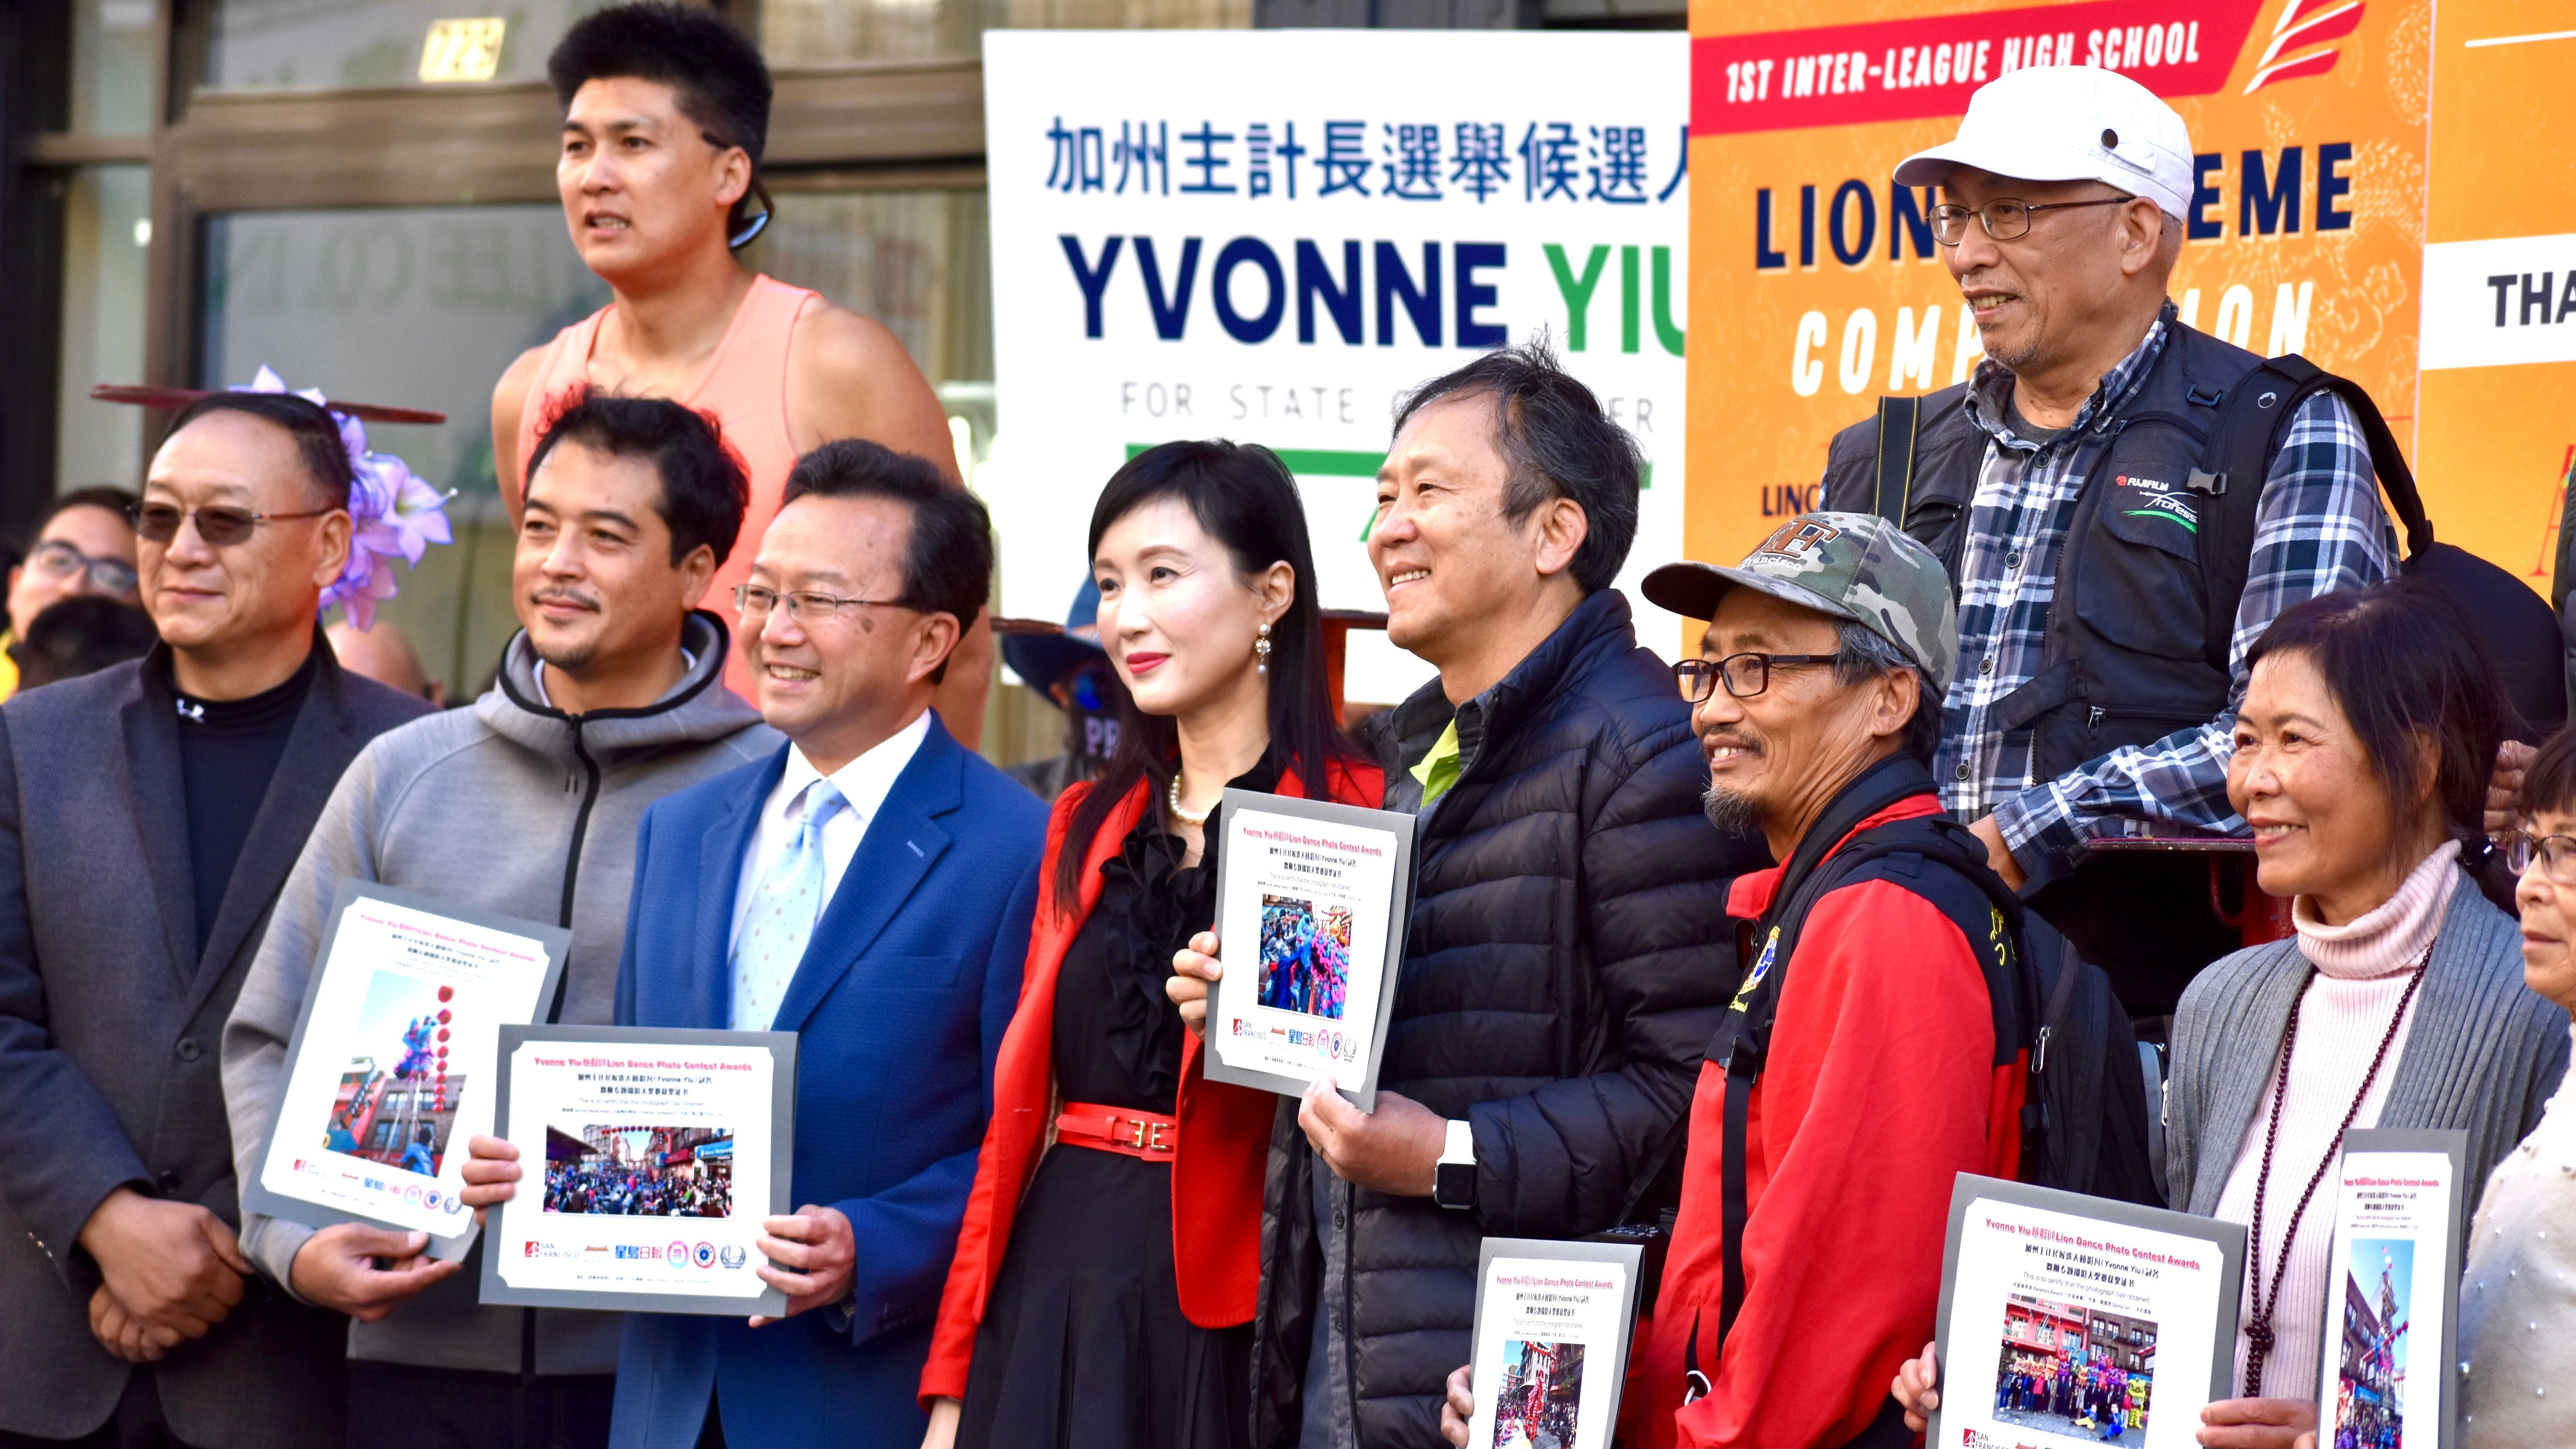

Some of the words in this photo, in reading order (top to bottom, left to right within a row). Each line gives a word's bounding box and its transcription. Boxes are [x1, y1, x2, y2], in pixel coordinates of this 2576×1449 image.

[1726, 59, 1774, 103] 1ST
[1781, 39, 1990, 99] INTER-LEAGUE
[2001, 32, 2074, 77] HIGH
[2086, 20, 2199, 70] SCHOOL
[1755, 178, 1935, 270] LION
[1058, 234, 1508, 349] YVONNE
[1541, 242, 1686, 358] YIU
[1121, 380, 1194, 418] FOR
[1229, 383, 1355, 423] STATE
[2127, 477, 2169, 491] FUJIFILM
[1243, 827, 1262, 838] Yvonne
[1264, 830, 1273, 839] Yiu
[1289, 834, 1301, 843] Lion
[1303, 836, 1321, 847] Dance
[1322, 839, 1338, 850] Photo
[1340, 841, 1360, 853] Contest
[1361, 845, 1382, 857] Awards
[1242, 1021, 1252, 1029] SAN
[1242, 1029, 1267, 1040] FRANCISCO
[535, 1057, 565, 1066] Yvonne
[628, 1060, 654, 1068] Dance
[684, 1062, 717, 1070] Contest
[720, 1063, 752, 1071] Awards
[615, 1245, 662, 1259] 星島日報
[1986, 1218, 2015, 1233] Yvonne
[2018, 1225, 2031, 1236] Yiu
[2056, 1233, 2074, 1245] Lion
[2076, 1236, 2103, 1251] Dance
[2105, 1242, 2130, 1256] Photo
[2132, 1248, 2166, 1264] Contest
[2167, 1255, 2200, 1270] Awards
[1497, 1276, 1512, 1285] Yvonne
[1534, 1278, 1543, 1286] Lion
[1544, 1278, 1559, 1287] Dance
[1560, 1279, 1574, 1288] Photo
[1575, 1279, 1594, 1288] Contest
[1595, 1280, 1613, 1289] Awards
[2048, 1278, 2063, 1286] certify
[2086, 1285, 2114, 1296] photograph
[2127, 1294, 2149, 1303] obtained
[1977, 1432, 1989, 1442] SAN
